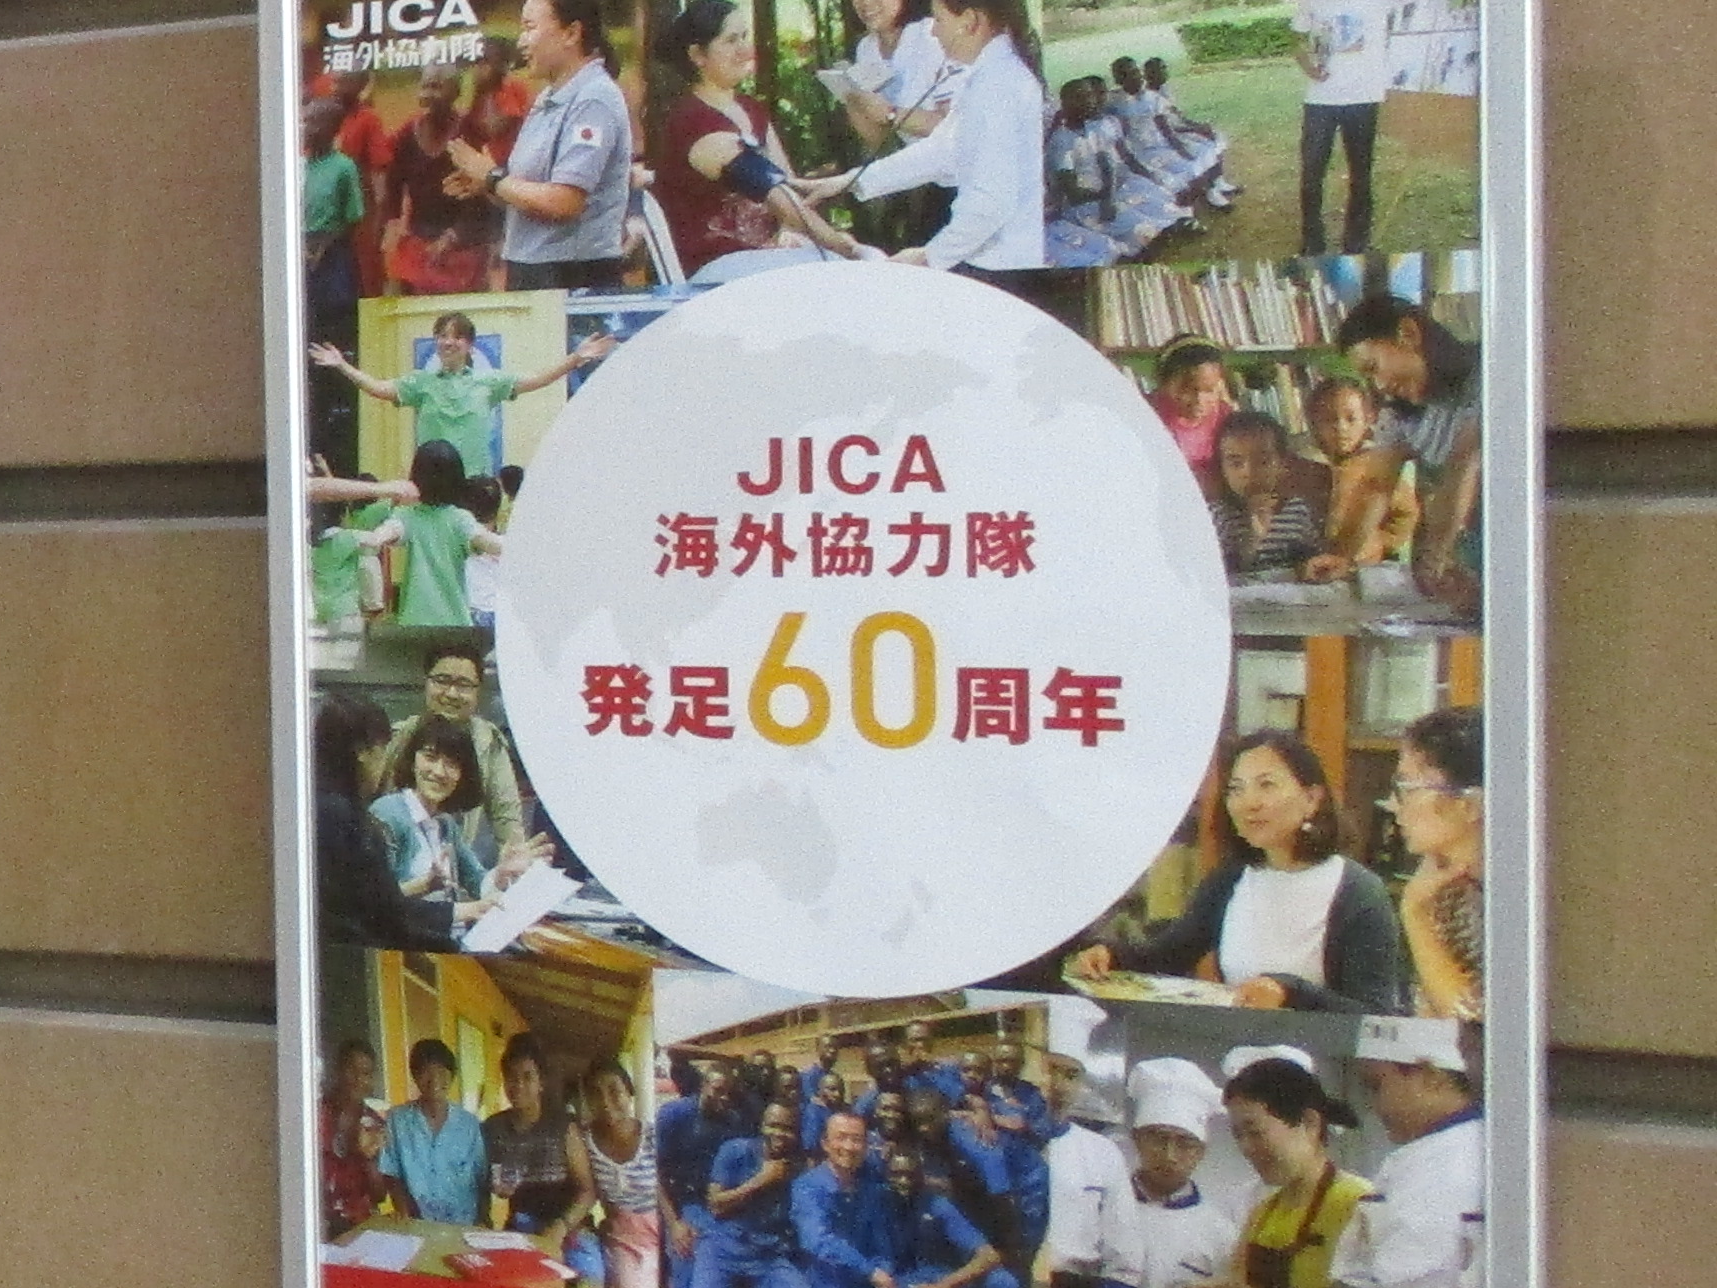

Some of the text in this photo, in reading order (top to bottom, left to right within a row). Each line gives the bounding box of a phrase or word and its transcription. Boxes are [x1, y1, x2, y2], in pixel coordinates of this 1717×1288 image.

[322, 30, 489, 74] 海外協力隊
[737, 435, 948, 496] JICA
[655, 512, 1038, 581] 海外協力隊
[580, 610, 1126, 749] 発足60周年
